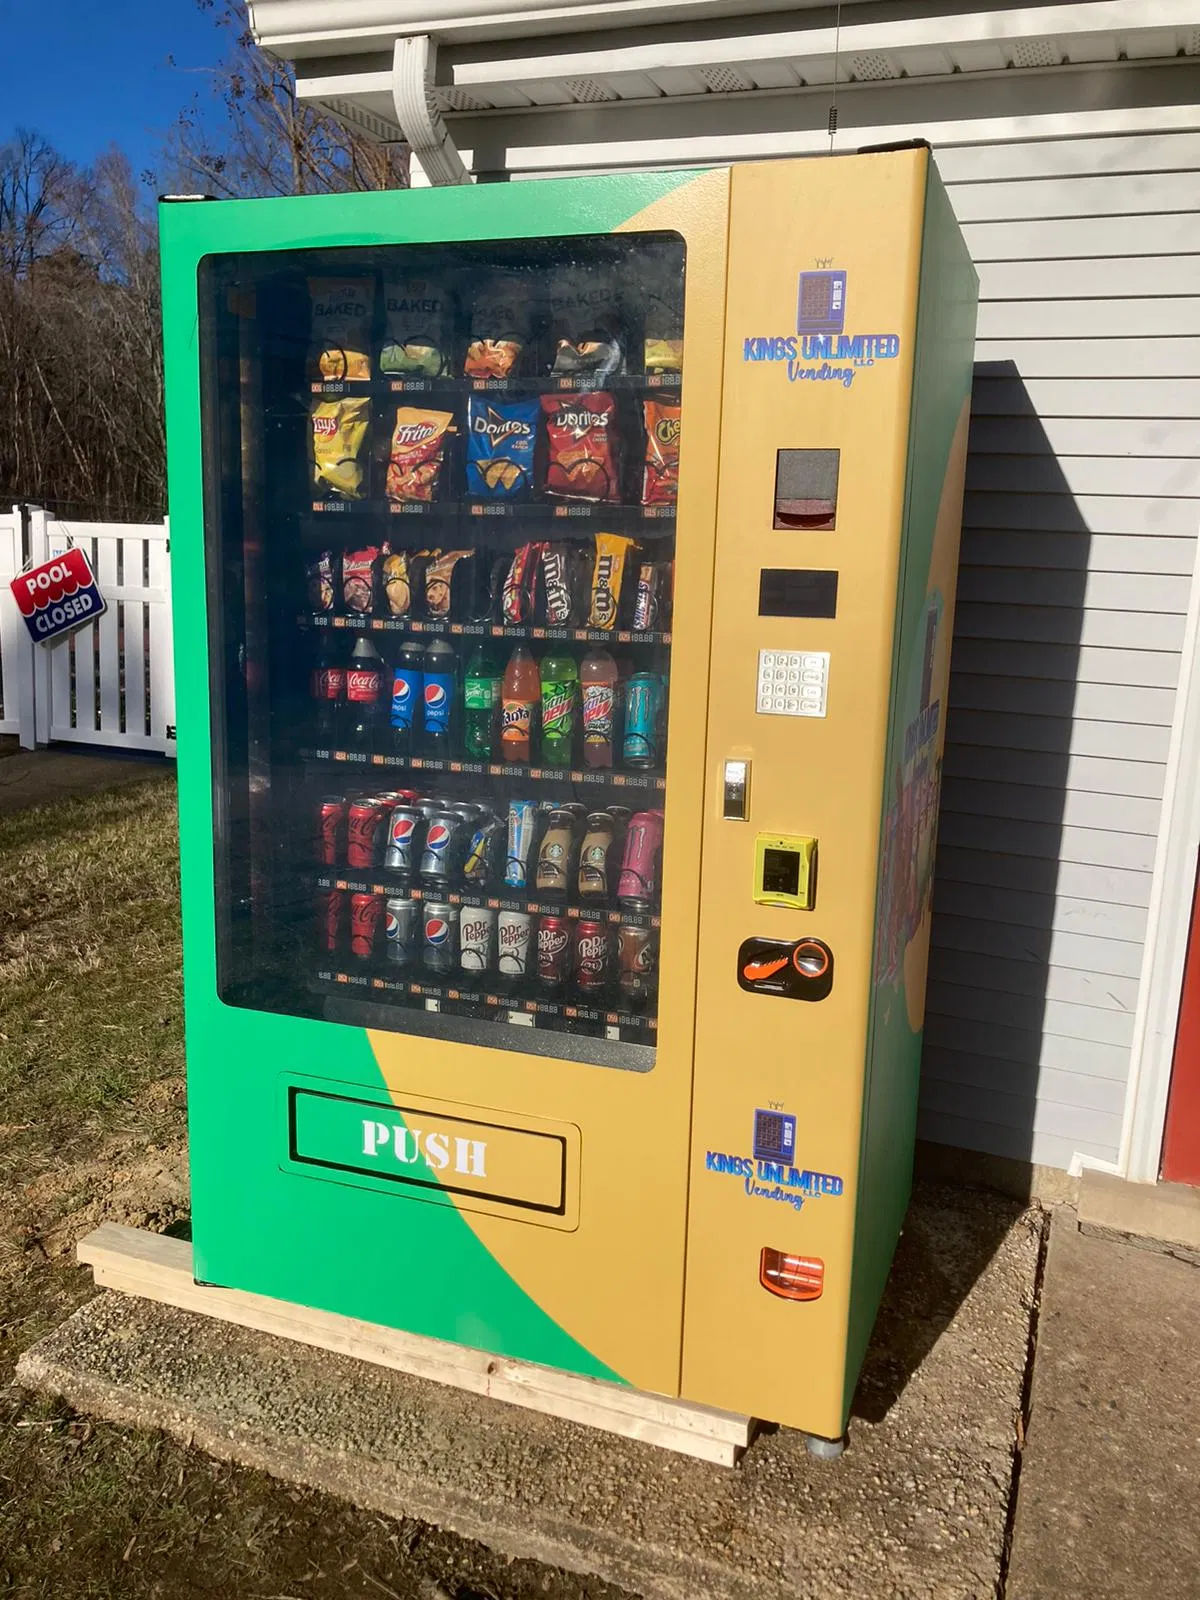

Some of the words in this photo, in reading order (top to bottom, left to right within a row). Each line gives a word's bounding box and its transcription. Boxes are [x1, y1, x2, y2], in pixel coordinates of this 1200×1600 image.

[744, 337, 797, 360] KINGS
[802, 335, 898, 359] UNLIMITED
[788, 362, 855, 387] Vending
[474, 416, 531, 434] Doritos
[556, 411, 608, 427] Doritos
[26, 562, 73, 595] POOL
[35, 593, 93, 633] CLOSED
[350, 672, 382, 688] Coca-Co
[426, 709, 444, 717] pepsi
[503, 707, 529, 724] anta
[499, 926, 529, 946] Pepper
[363, 1120, 487, 1177] PUSH
[707, 1152, 753, 1176] KINGS
[758, 1161, 843, 1195] UNLIMITED
[745, 1178, 804, 1210] Vending
